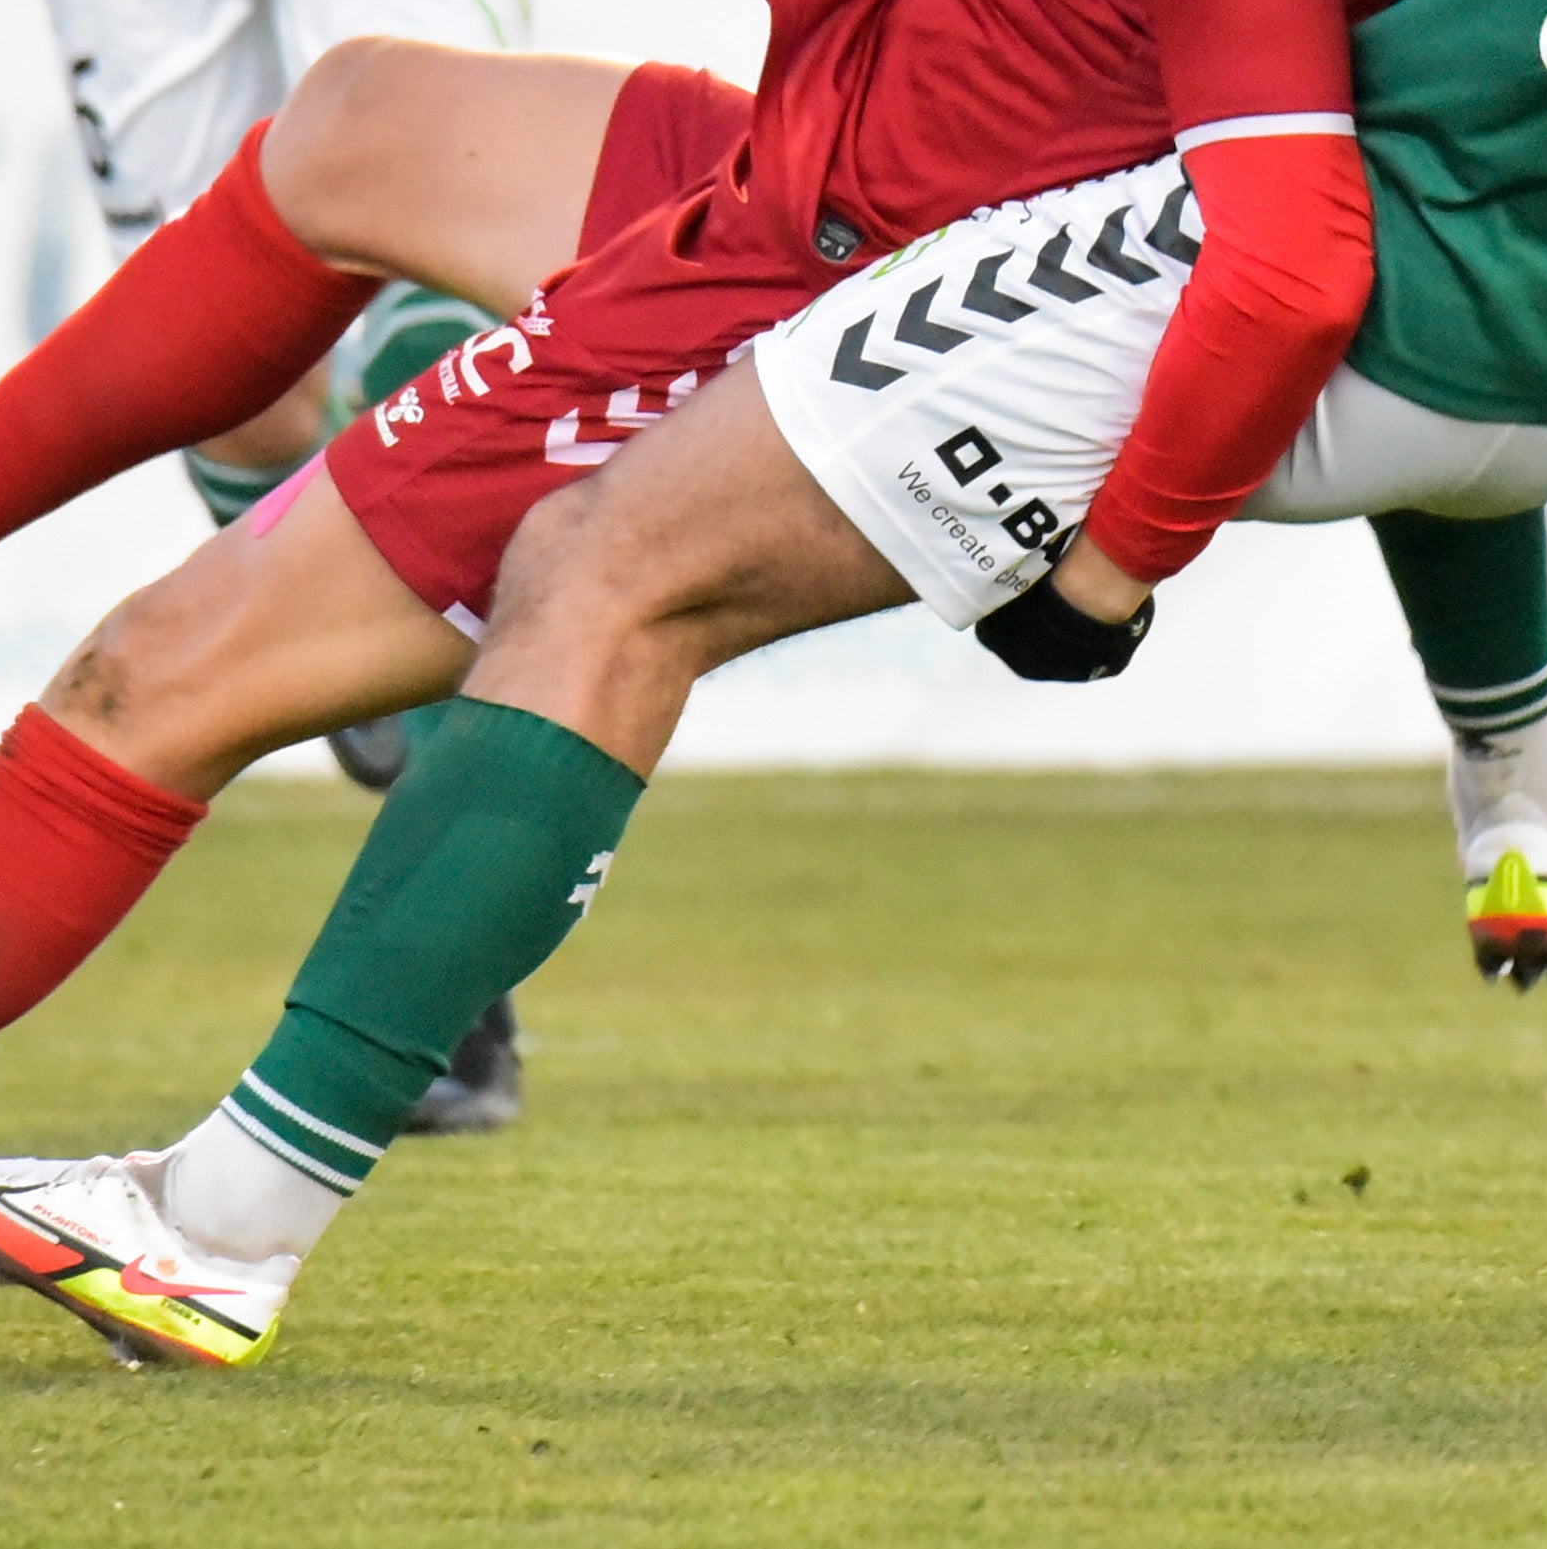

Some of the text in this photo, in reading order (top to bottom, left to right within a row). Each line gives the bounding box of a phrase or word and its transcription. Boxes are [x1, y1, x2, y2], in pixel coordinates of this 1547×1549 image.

[897, 460, 1032, 594] We create che
